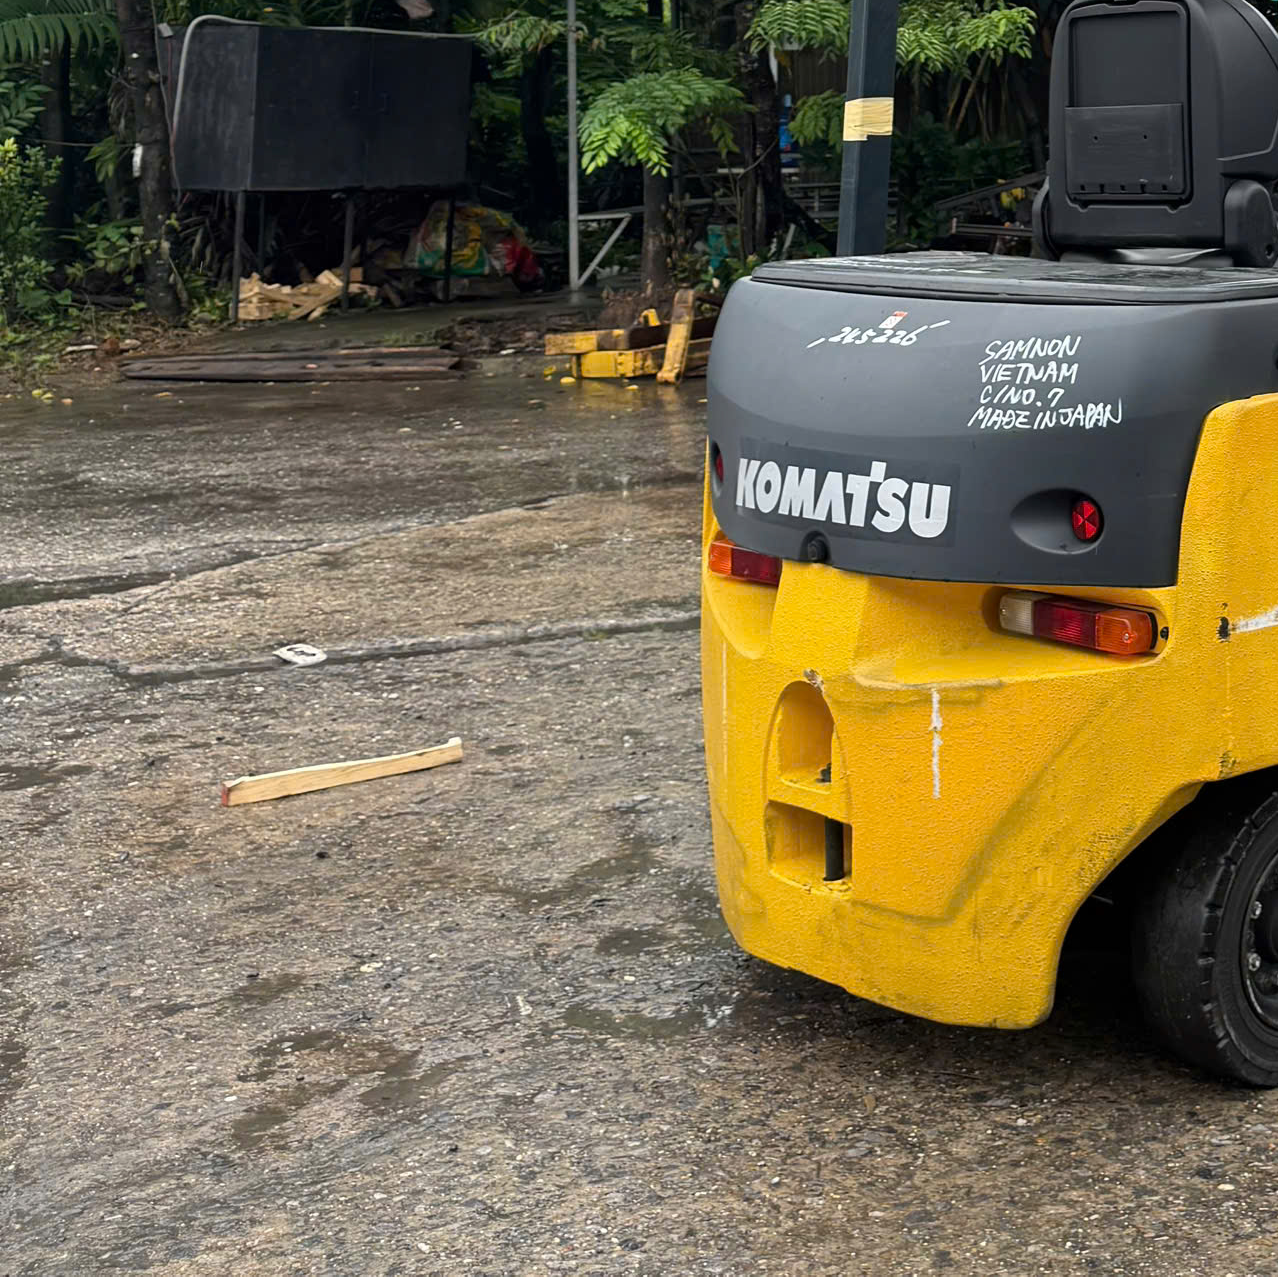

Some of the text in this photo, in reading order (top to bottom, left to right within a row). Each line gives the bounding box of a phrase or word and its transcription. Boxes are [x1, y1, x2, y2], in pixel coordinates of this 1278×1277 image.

[978, 335, 1082, 365] SAMNON
[980, 361, 1079, 384] VIETNAM
[1047, 388, 1065, 408] 7
[967, 398, 1123, 430] MADE IN JAPAN
[736, 458, 951, 538] KOMATSU
